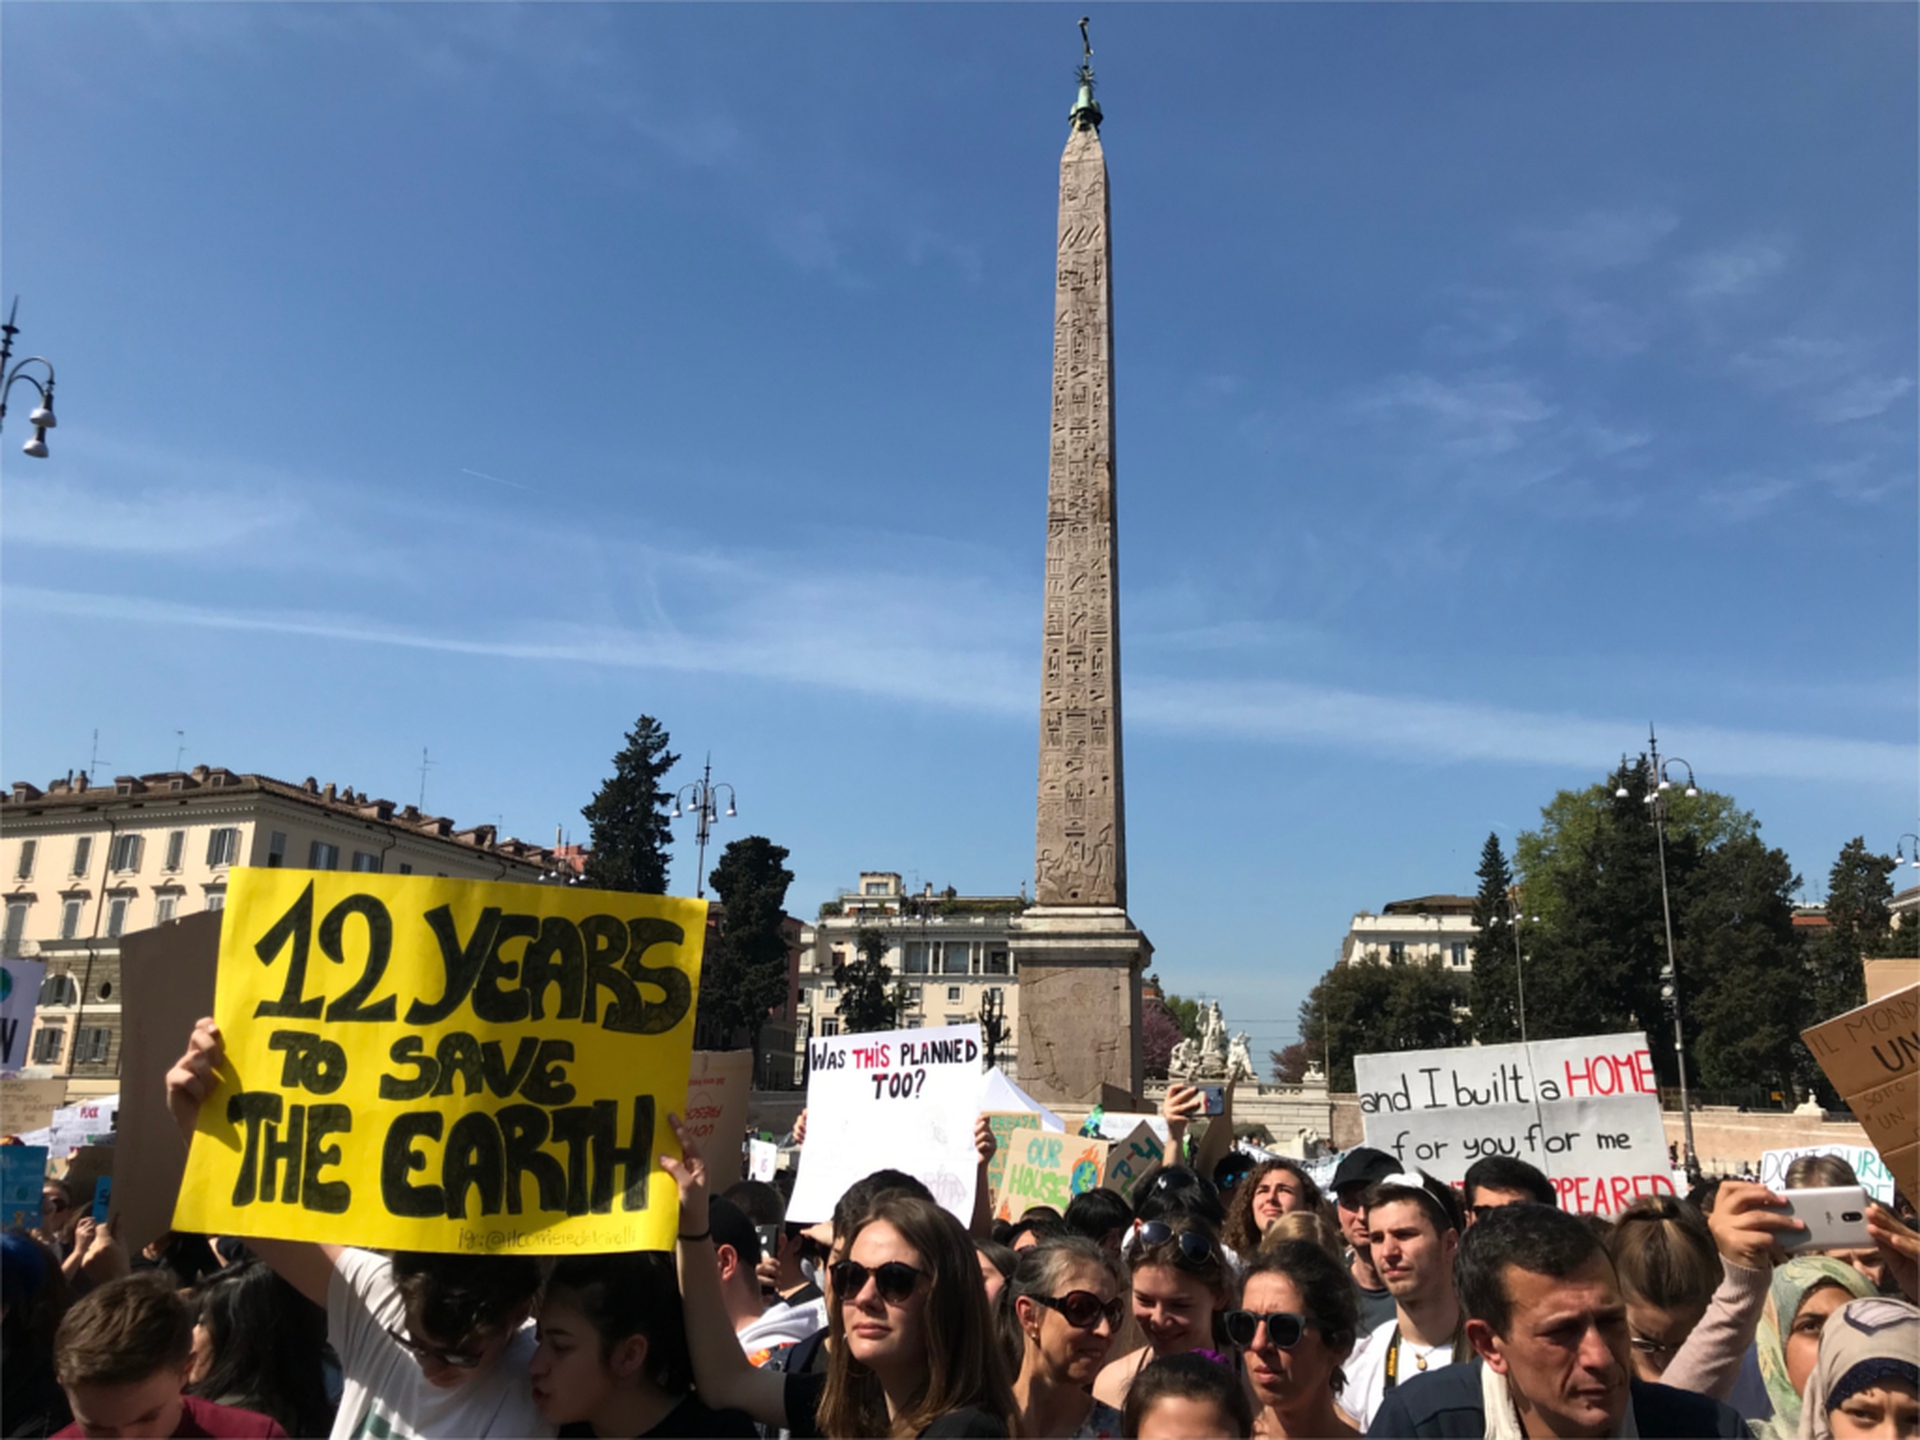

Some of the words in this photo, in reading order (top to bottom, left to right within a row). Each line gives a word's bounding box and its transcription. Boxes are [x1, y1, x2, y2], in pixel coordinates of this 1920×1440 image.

[253, 878, 397, 1023] 12
[403, 904, 692, 1035] YEARS
[900, 1038, 978, 1067] PLANNED
[1811, 1033, 1840, 1056] IL
[269, 1031, 347, 1095] TO
[379, 1032, 576, 1105] SAVE
[872, 1068, 926, 1100] TOO?
[1359, 1073, 1412, 1114] and
[1418, 1067, 1447, 1109] I
[1452, 1062, 1529, 1107] built
[1539, 1079, 1561, 1101] a
[1564, 1050, 1658, 1098] HOME
[227, 1091, 352, 1214] THE
[380, 1095, 655, 1220] EARTH
[1027, 1137, 1063, 1168] OUR
[1392, 1131, 1448, 1162] for
[1463, 1136, 1522, 1160] you,
[1523, 1124, 1581, 1153] for
[1597, 1133, 1632, 1151] me
[1008, 1164, 1069, 1211] HOUSE
